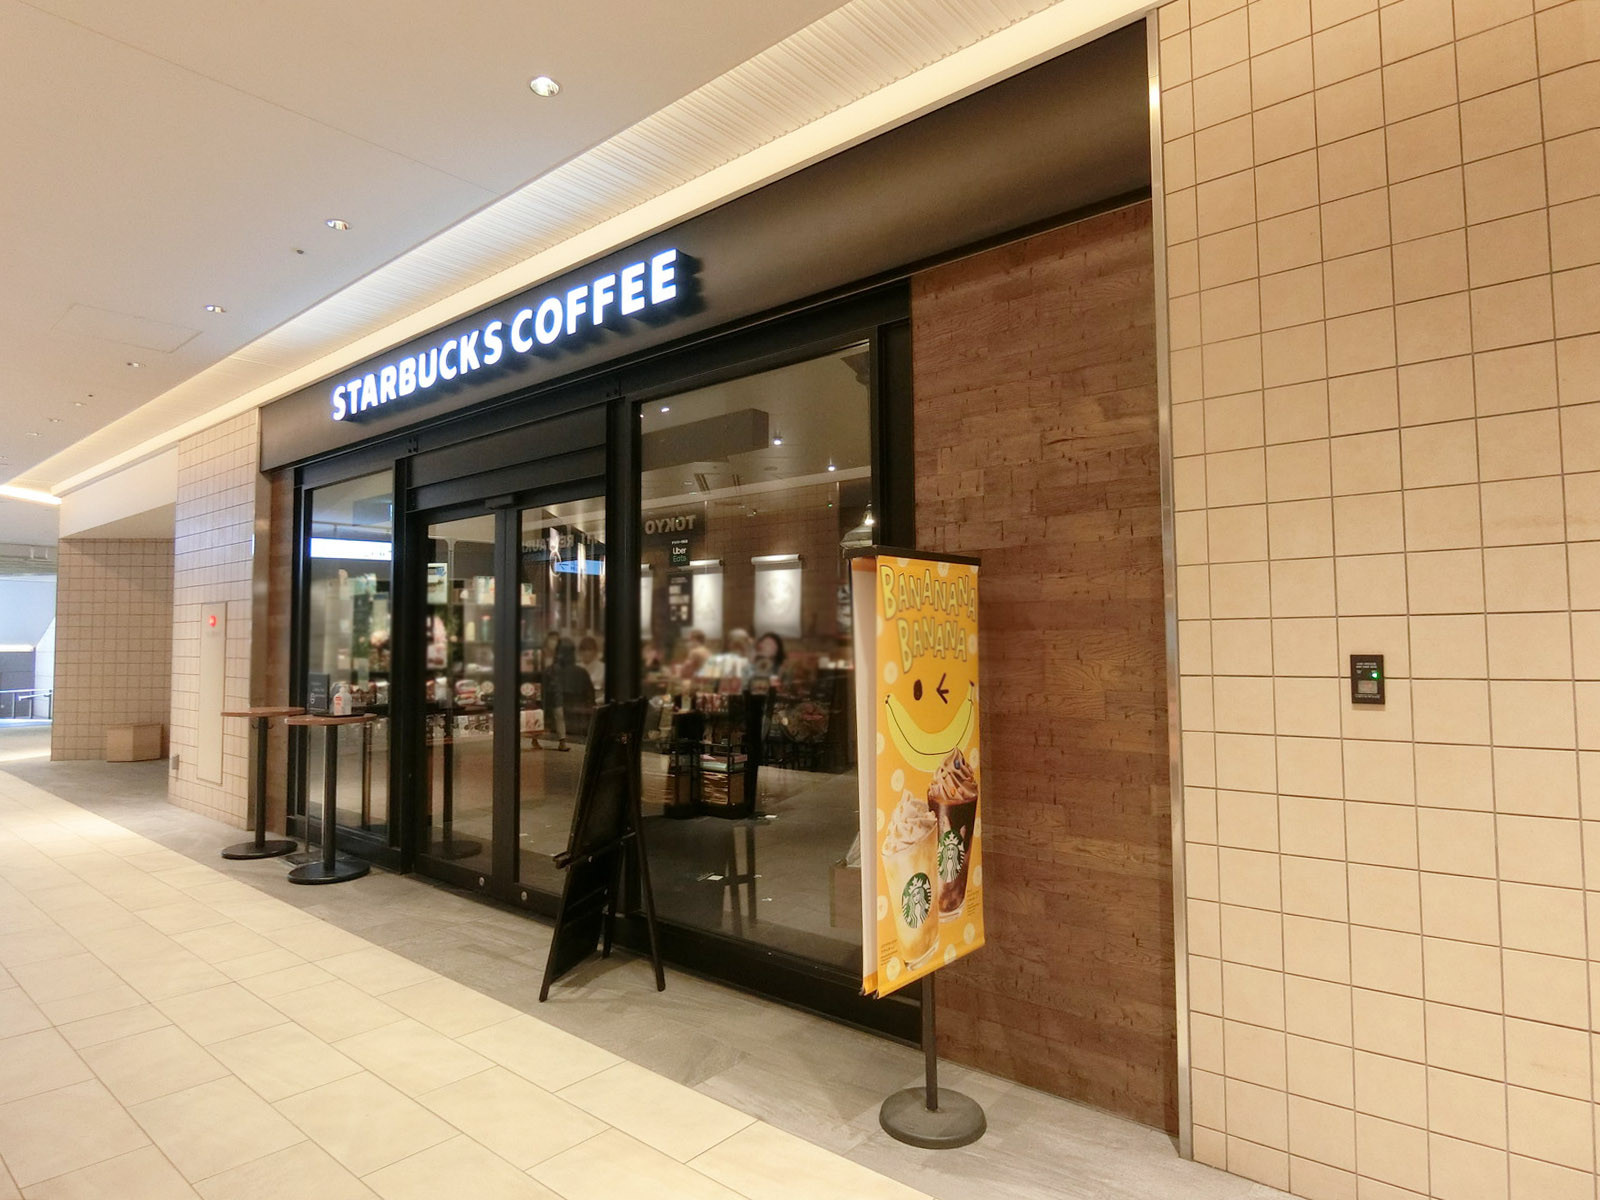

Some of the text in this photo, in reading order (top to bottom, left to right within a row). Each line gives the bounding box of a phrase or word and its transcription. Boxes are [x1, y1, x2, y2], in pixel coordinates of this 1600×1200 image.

[331, 248, 678, 421] STARBUCKS COFFEE
[672, 547, 687, 555] Uber
[672, 555, 687, 563] Eats
[879, 564, 977, 622] BANANANA
[896, 616, 968, 674] BANANA
